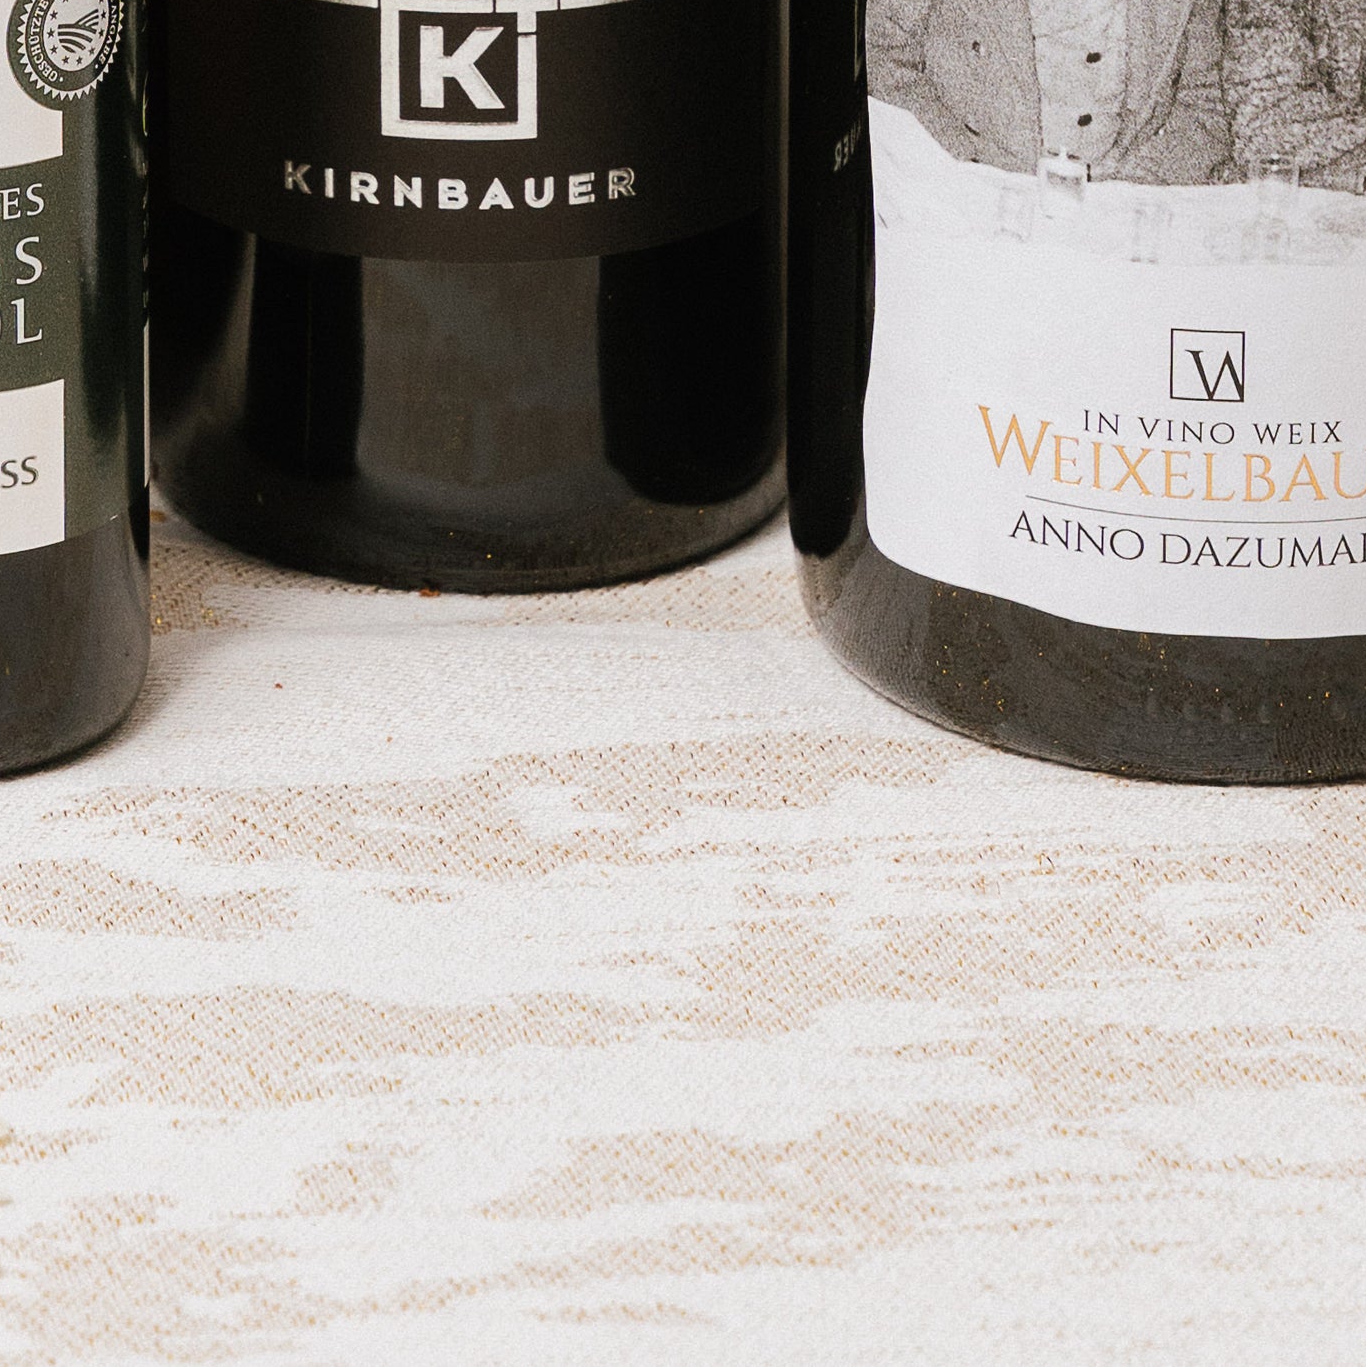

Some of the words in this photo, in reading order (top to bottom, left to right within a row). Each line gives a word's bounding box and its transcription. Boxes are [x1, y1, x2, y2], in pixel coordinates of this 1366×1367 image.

[99, 5, 117, 65] ANGABE
[419, 25, 506, 110] K
[283, 160, 637, 211] KIRNBAUER
[1083, 409, 1121, 435] IN
[1138, 416, 1235, 445] VINO
[1253, 421, 1343, 445] WEIX
[1009, 510, 1145, 562] ANNO
